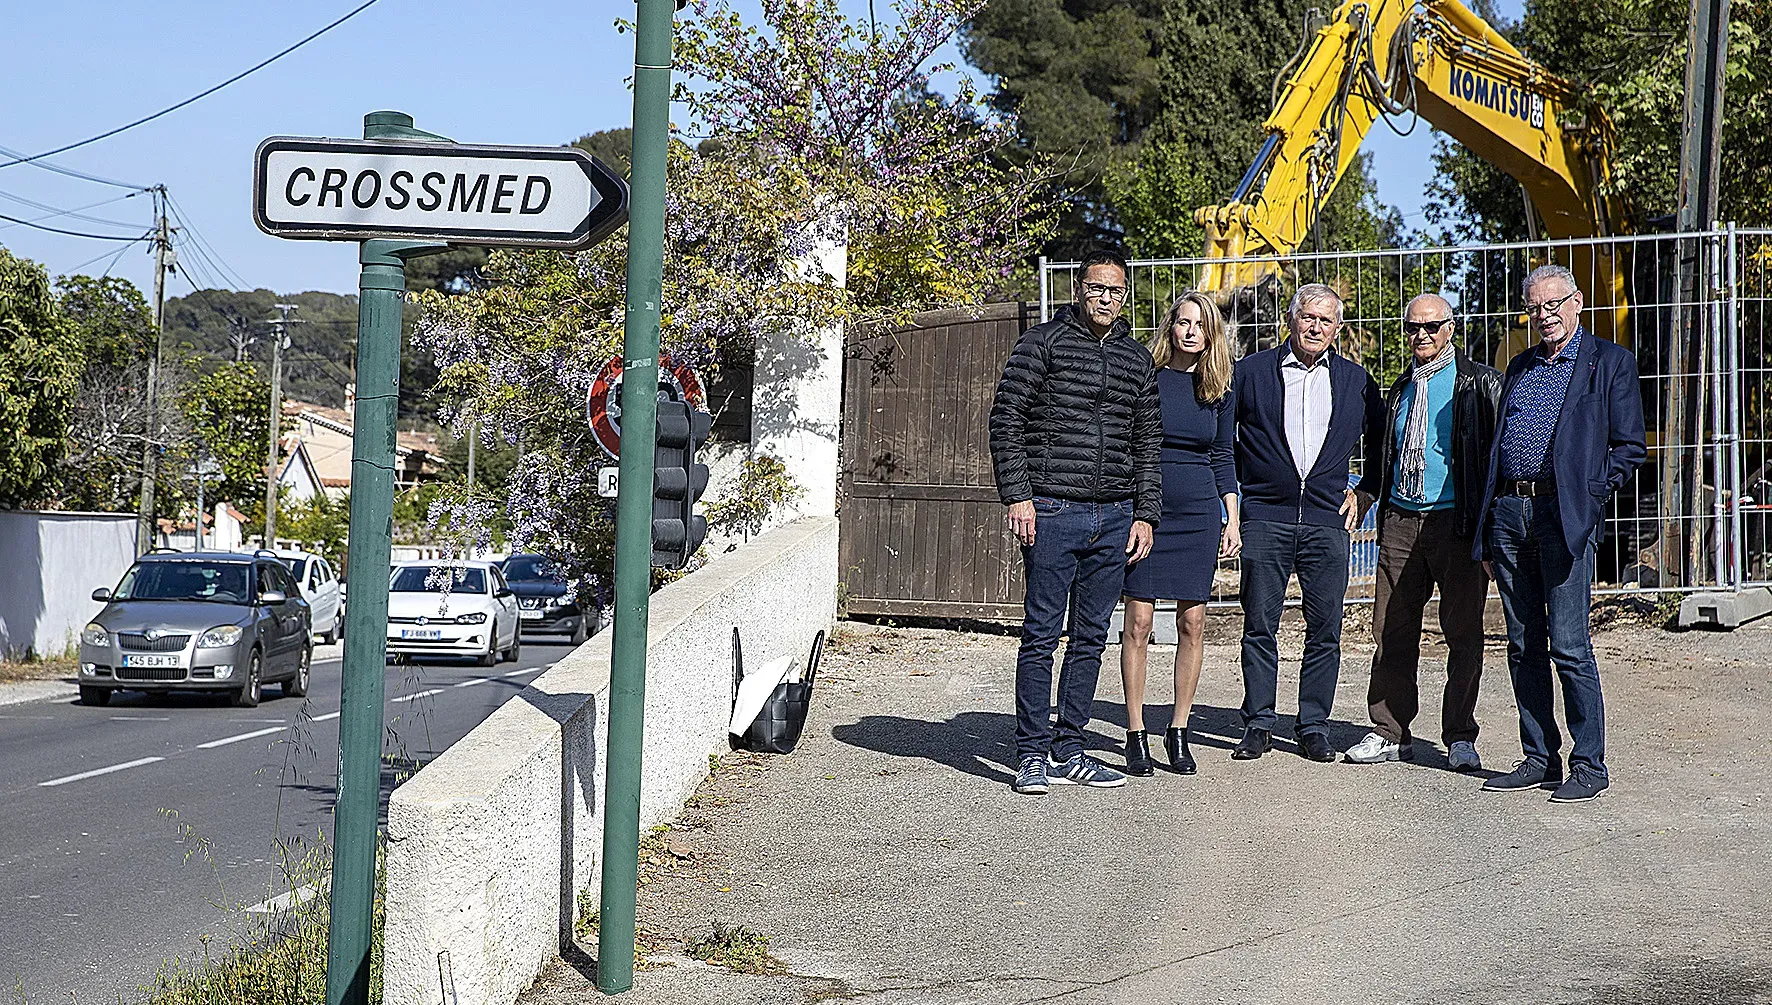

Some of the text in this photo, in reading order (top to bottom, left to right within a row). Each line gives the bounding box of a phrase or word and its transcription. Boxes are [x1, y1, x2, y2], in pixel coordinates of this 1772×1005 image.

[1449, 66, 1530, 121] KOMATSU
[284, 166, 552, 215] CROSSMED
[167, 657, 178, 666] 13
